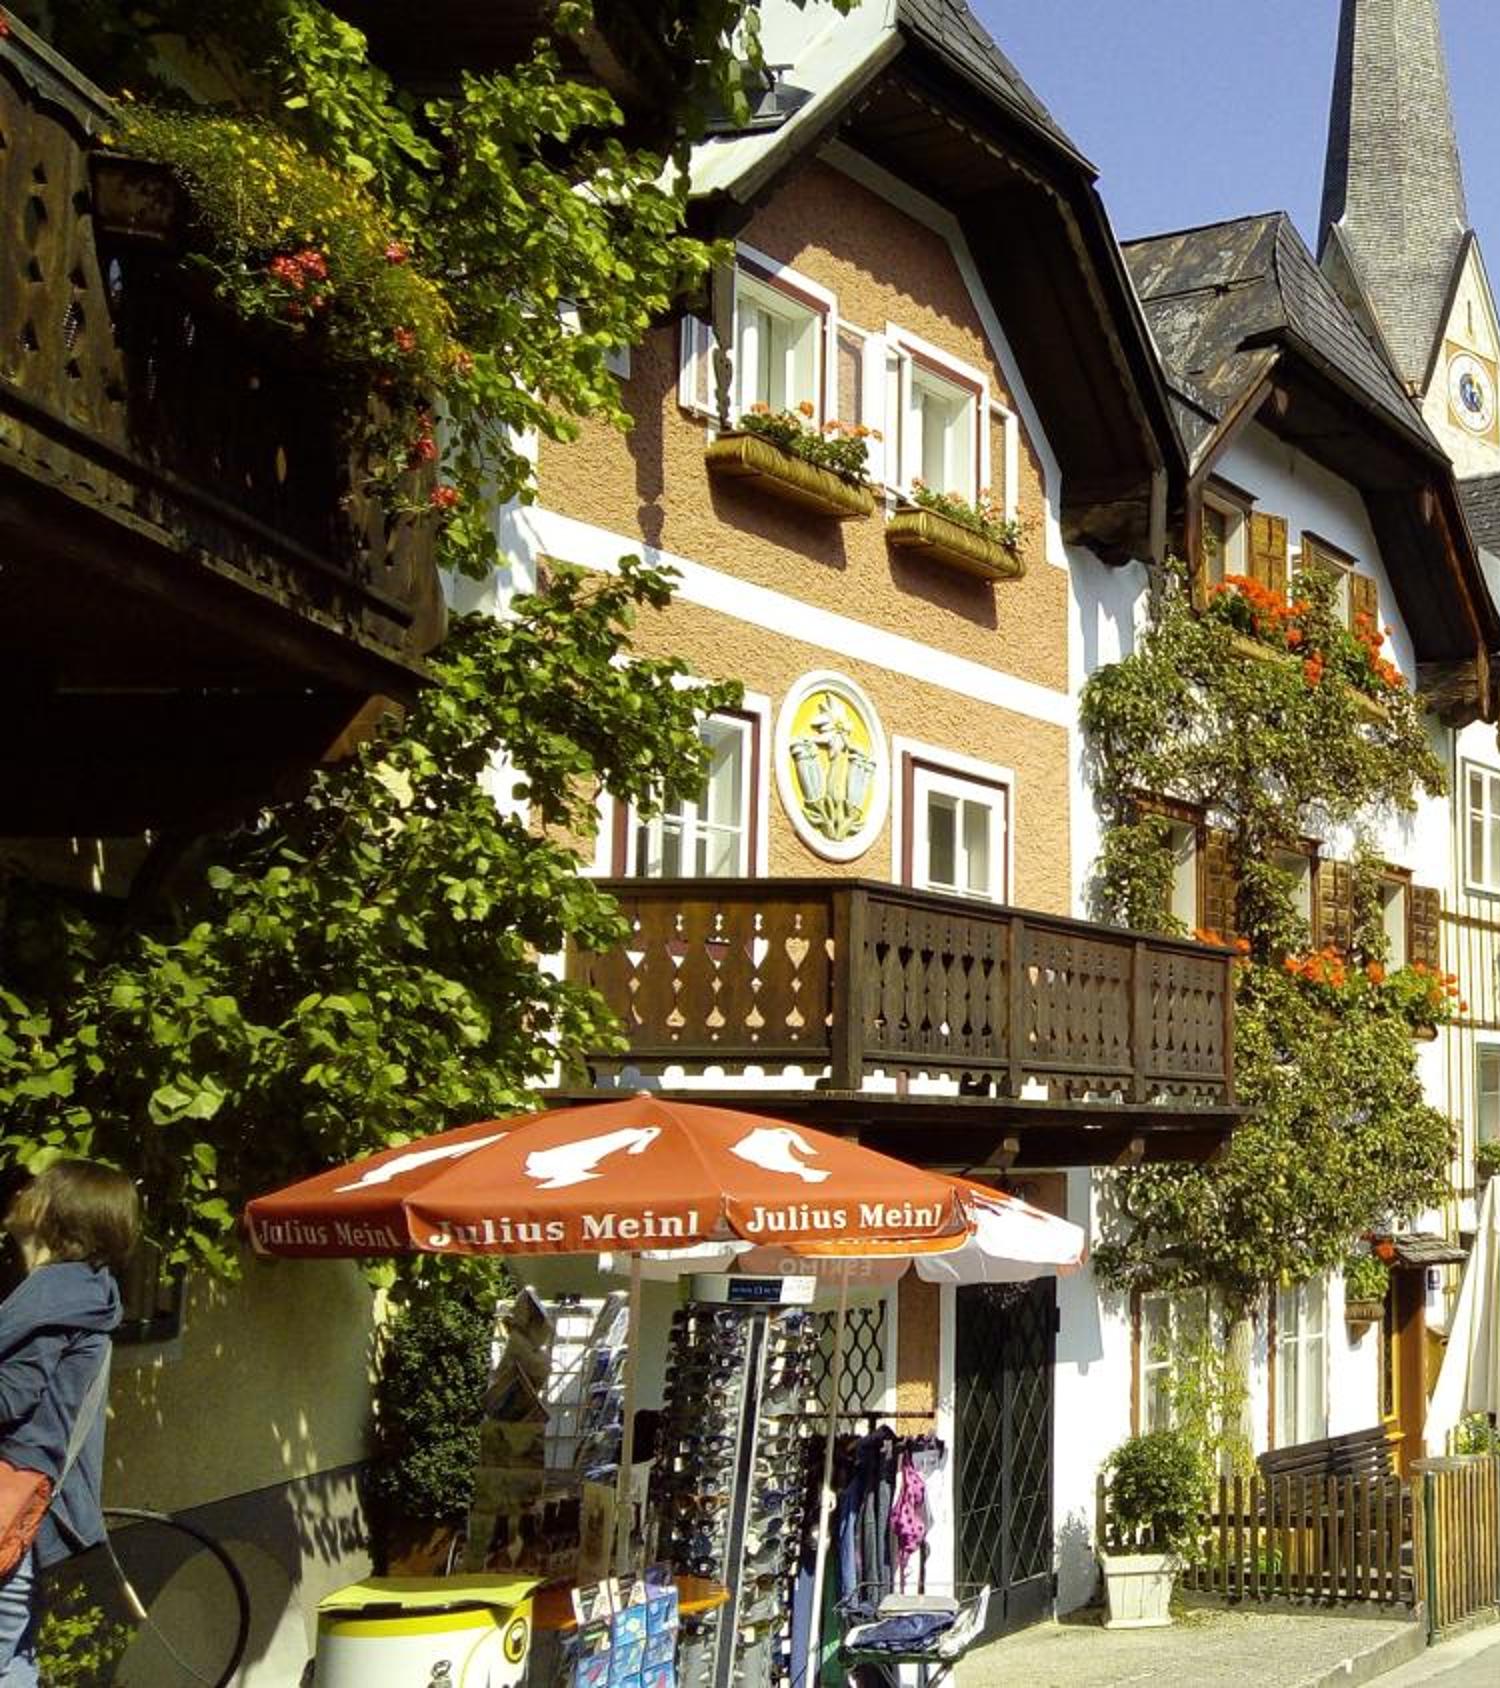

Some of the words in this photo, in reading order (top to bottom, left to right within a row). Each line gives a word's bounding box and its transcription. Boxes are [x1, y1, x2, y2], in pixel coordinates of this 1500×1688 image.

[428, 1217, 566, 1246] Julius
[582, 1211, 699, 1240] Meinl
[747, 1204, 847, 1232] Julius
[859, 1203, 943, 1228] Meinl
[260, 1219, 329, 1246] Julius
[334, 1222, 401, 1248] Meinl
